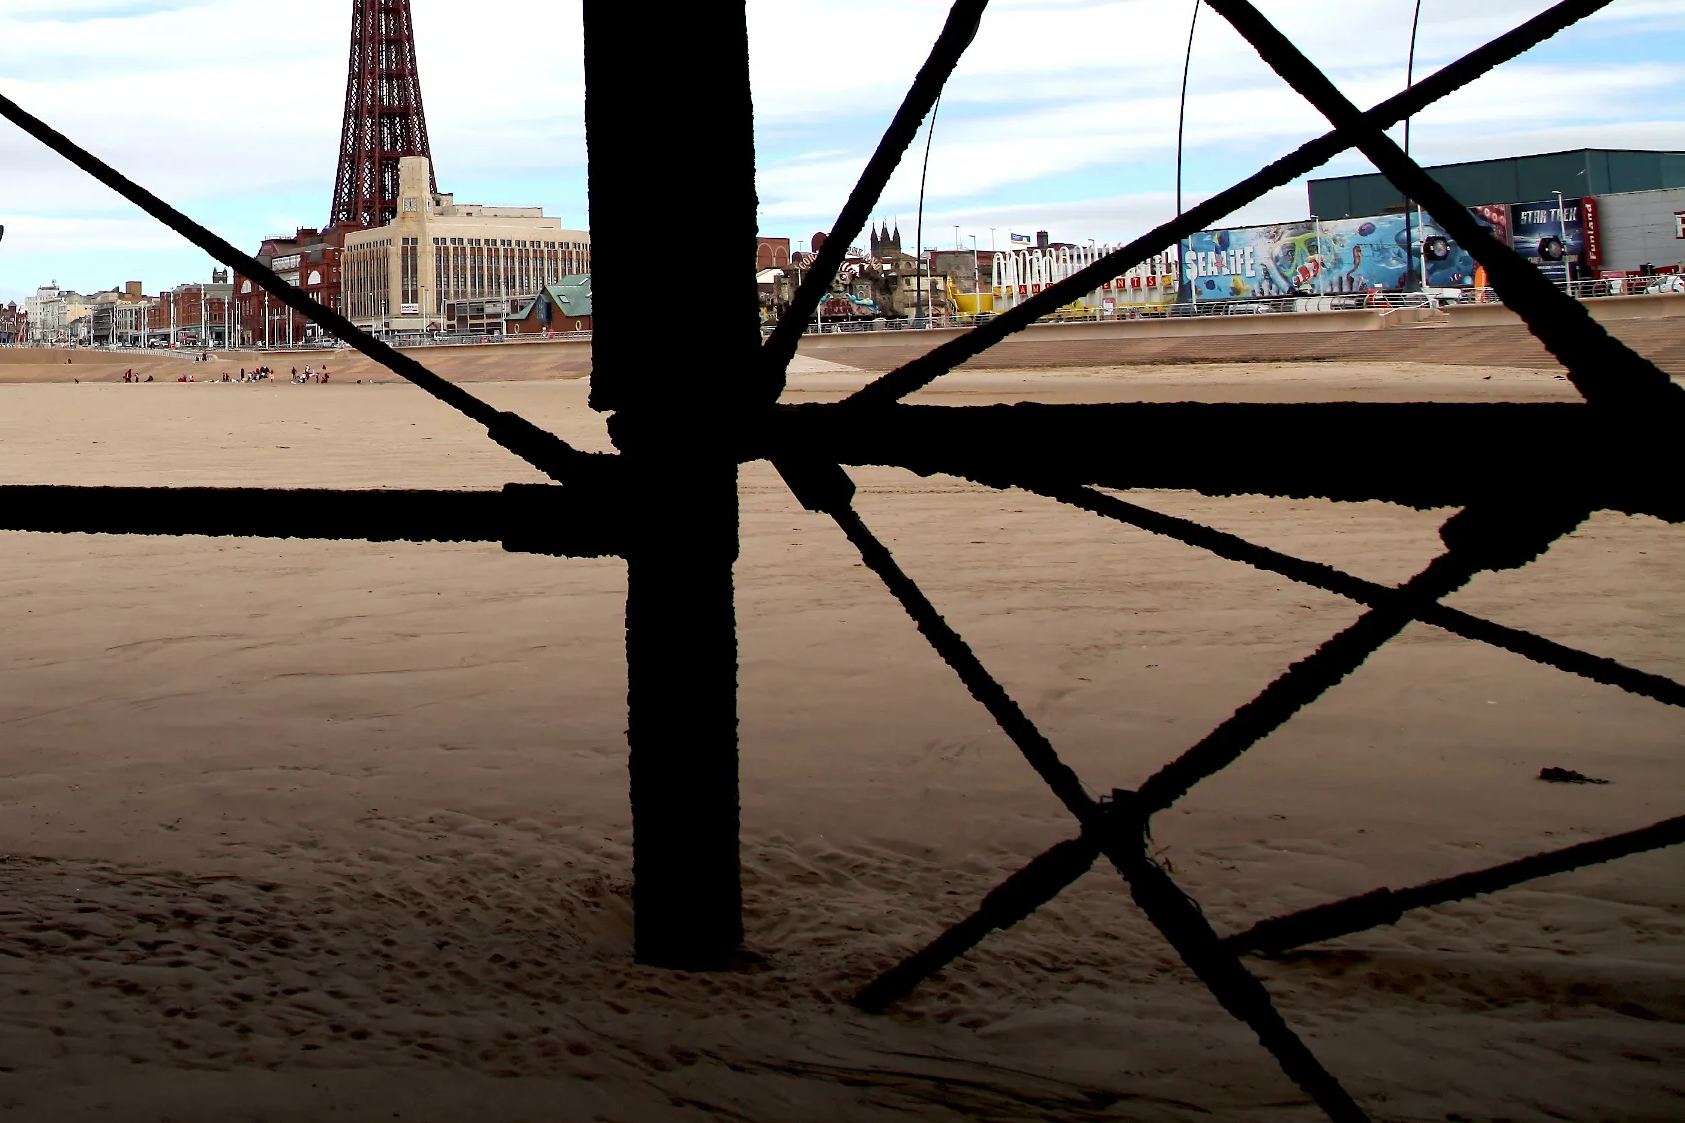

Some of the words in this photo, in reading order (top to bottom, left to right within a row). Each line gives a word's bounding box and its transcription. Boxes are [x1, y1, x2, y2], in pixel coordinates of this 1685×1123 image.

[1520, 210, 1547, 225] STAR
[1549, 207, 1577, 222] TREK
[1185, 248, 1219, 281] SEA
